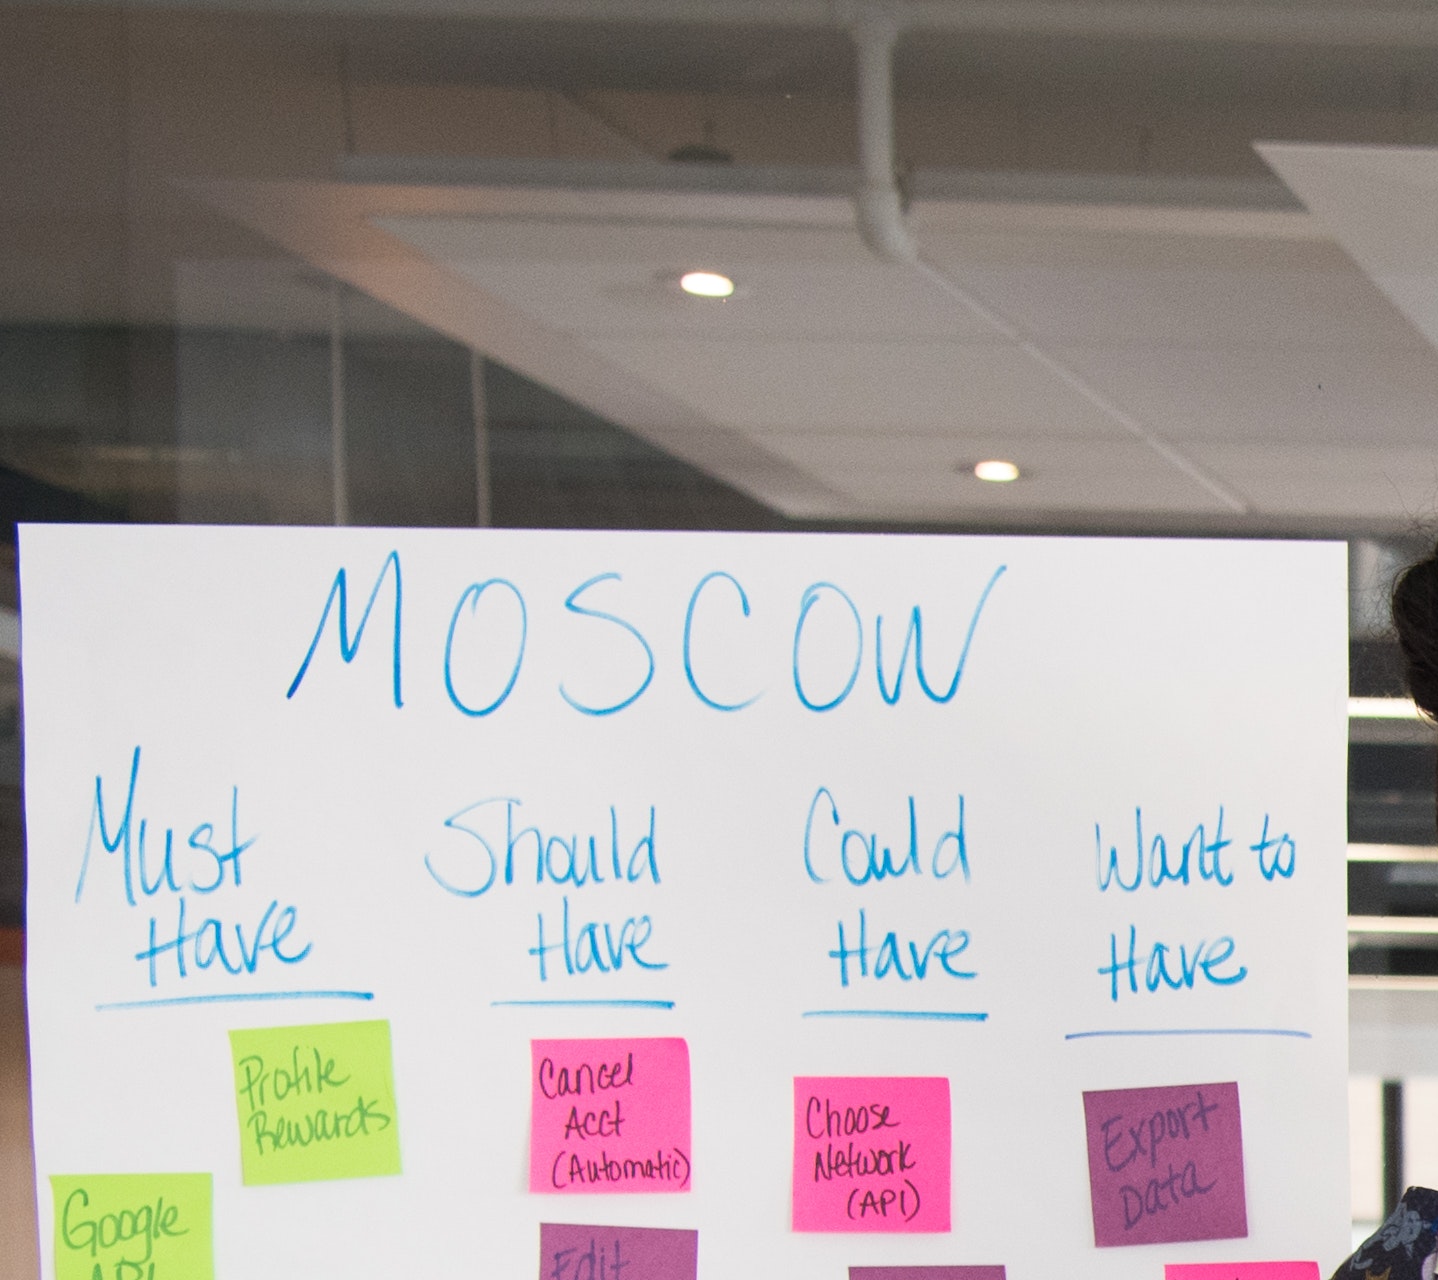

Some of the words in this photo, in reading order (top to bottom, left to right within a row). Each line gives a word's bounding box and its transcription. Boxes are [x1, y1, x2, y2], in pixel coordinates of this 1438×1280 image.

[286, 549, 1007, 719] MOSCOW
[75, 745, 260, 906] Must
[424, 797, 662, 898] Should
[803, 786, 972, 887] Could
[1094, 803, 1235, 892] Want
[1249, 813, 1296, 882] to
[135, 897, 314, 987] Have
[528, 895, 670, 982] Have
[828, 907, 979, 988] Have
[1097, 923, 1248, 1003] Have
[238, 1045, 351, 1102] Profile
[537, 1052, 635, 1100] Cancel
[247, 1097, 391, 1157] Rewards
[563, 1106, 626, 1141] Acct
[806, 1096, 901, 1139] Choose
[1101, 1091, 1220, 1173] Export
[551, 1149, 692, 1190] (Automatic)
[814, 1139, 917, 1184] Network
[847, 1179, 921, 1222] (API)
[1120, 1158, 1219, 1231] Data
[61, 1188, 190, 1265] Google
